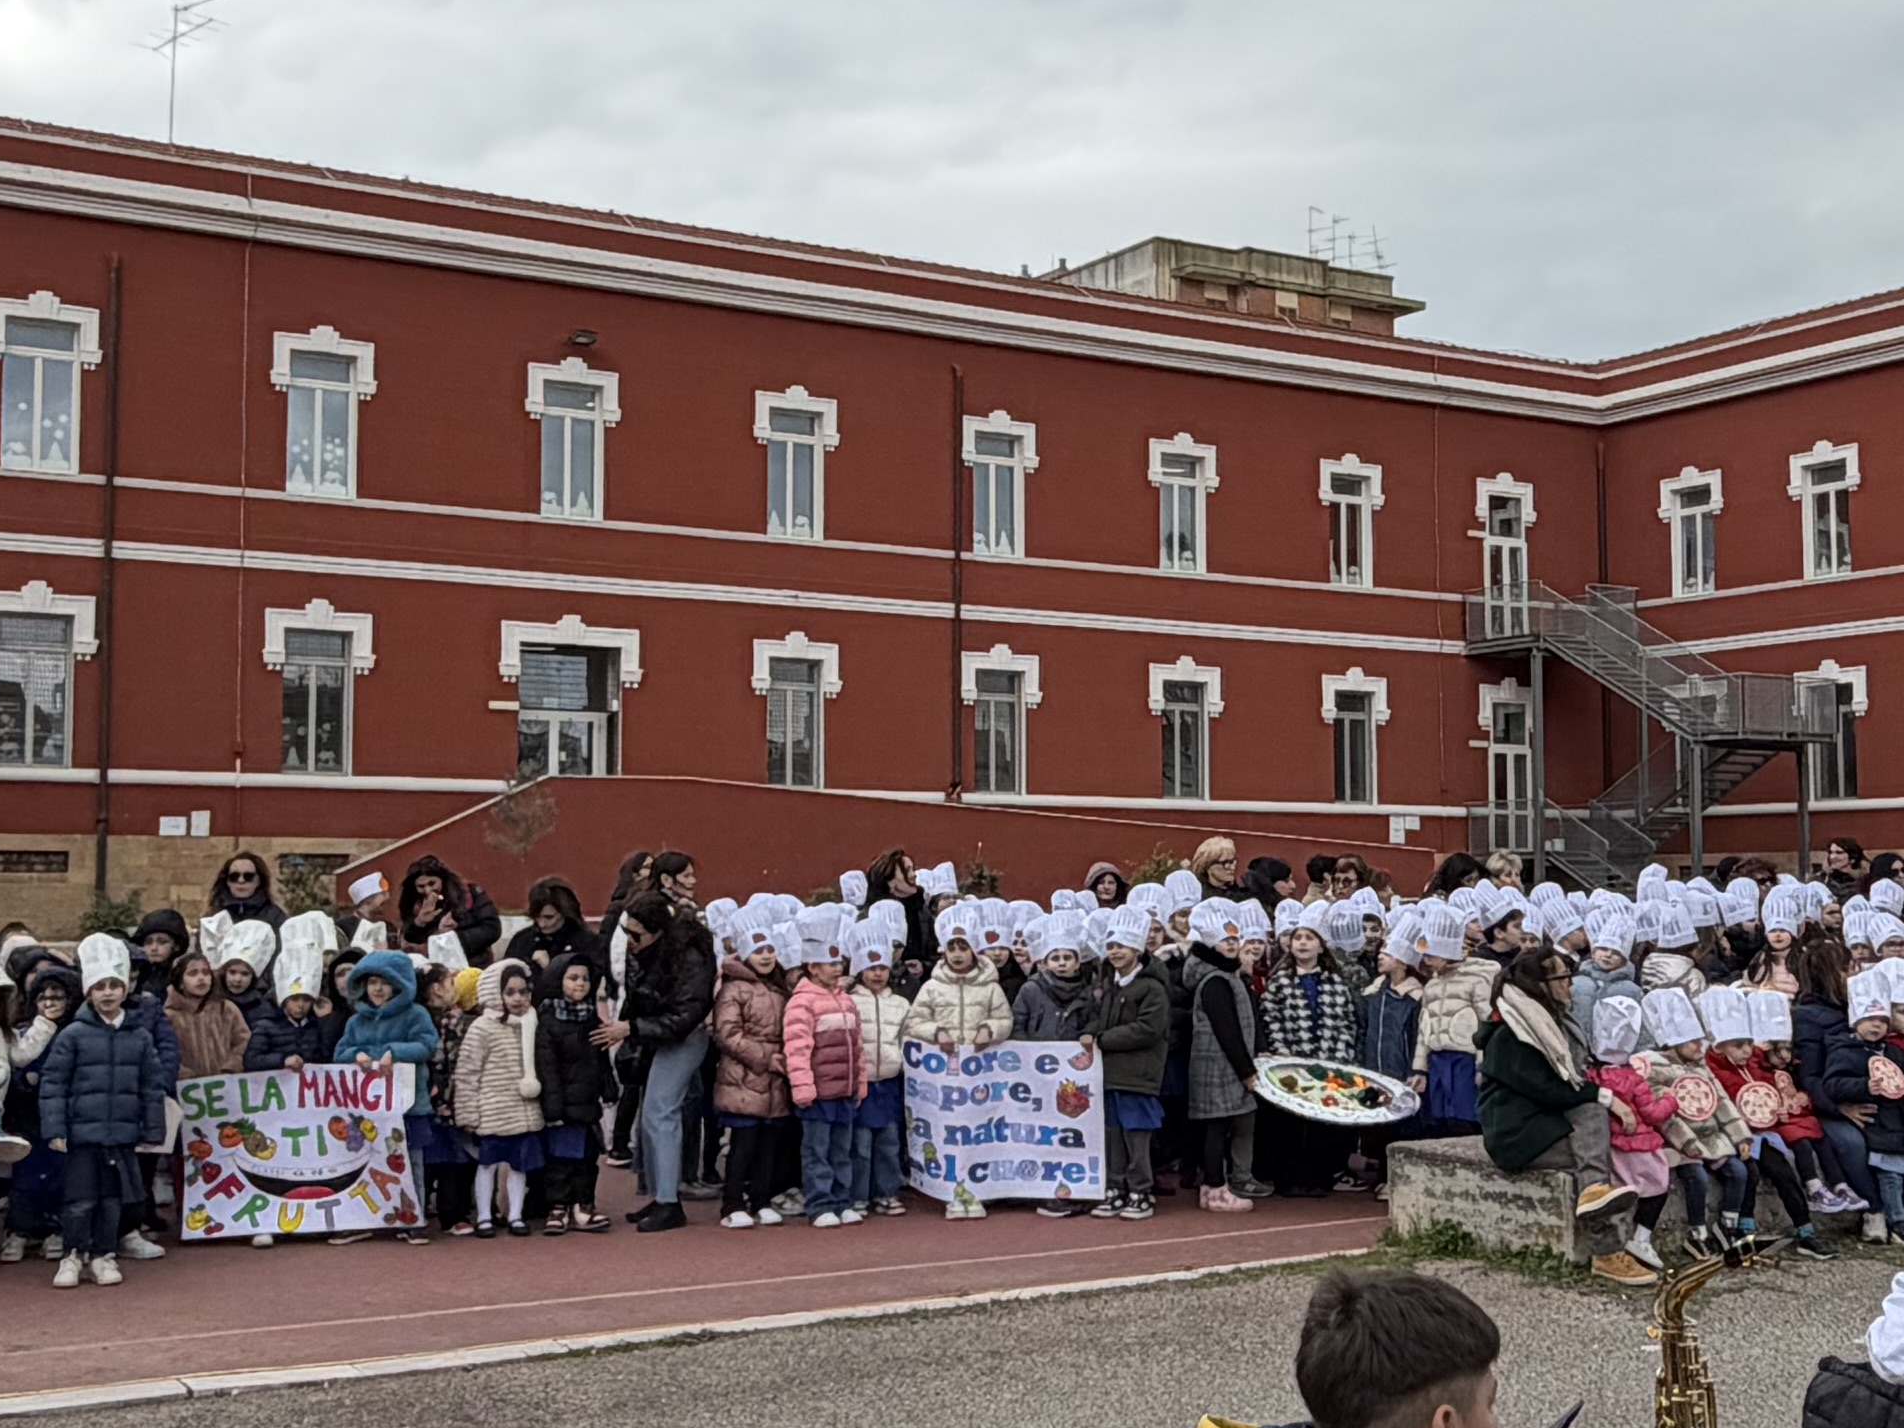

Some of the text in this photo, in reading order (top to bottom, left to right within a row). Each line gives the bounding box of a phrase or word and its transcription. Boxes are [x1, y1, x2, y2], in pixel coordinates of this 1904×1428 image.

[1034, 1054, 1060, 1074] e
[180, 1069, 394, 1121] SE LA MANGI
[906, 1076, 1043, 1112] sapore,
[280, 1124, 329, 1157] TI
[942, 1115, 1086, 1148] natura
[203, 1167, 401, 1234] FRUTTA
